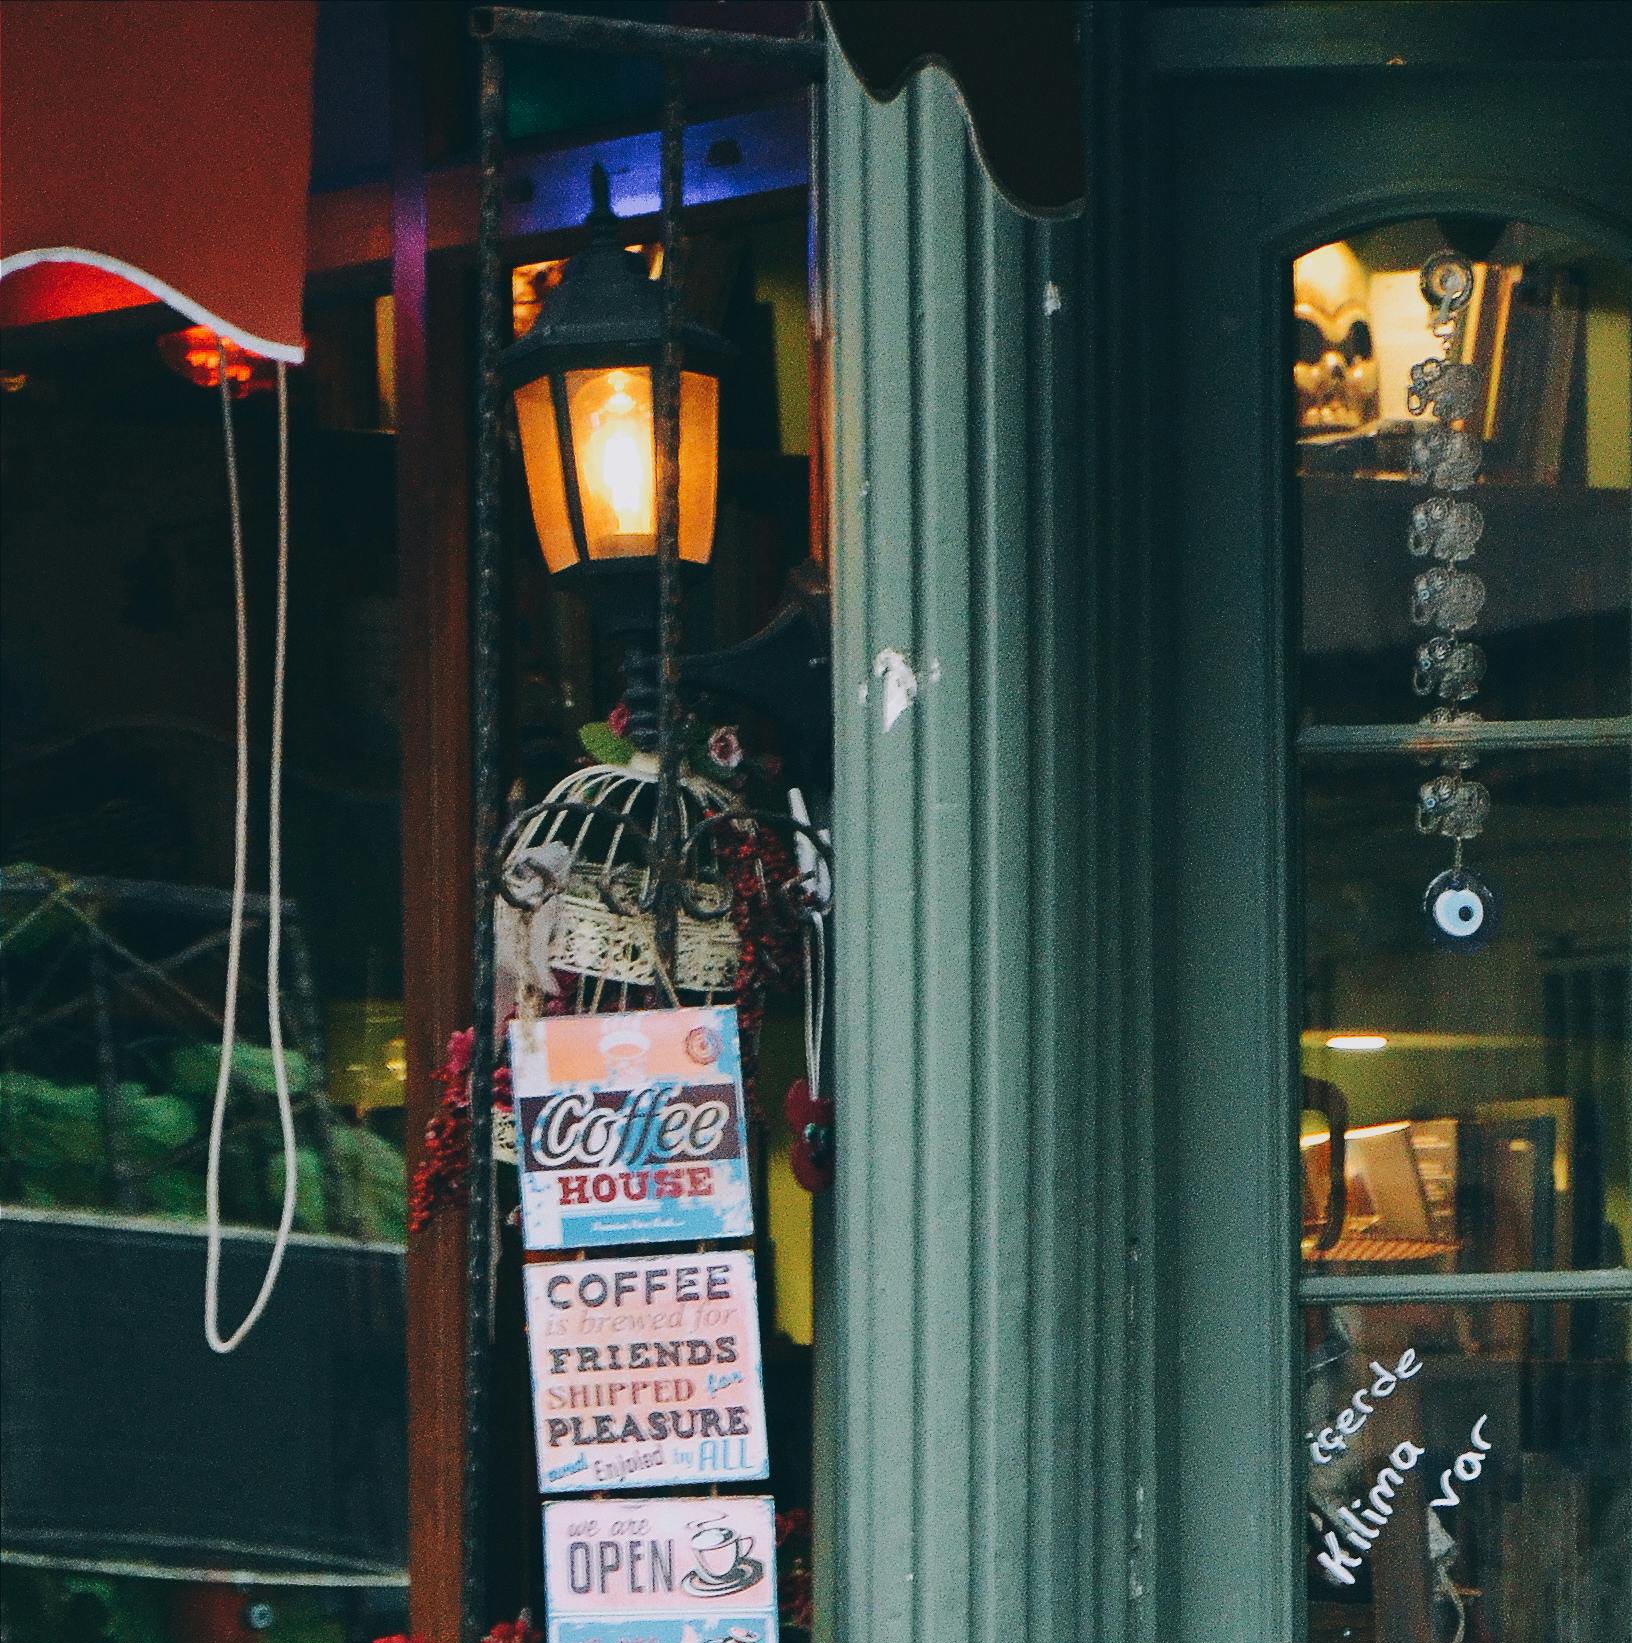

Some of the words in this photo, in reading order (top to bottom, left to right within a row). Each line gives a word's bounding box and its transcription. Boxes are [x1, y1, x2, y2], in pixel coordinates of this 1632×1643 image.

[531, 1086, 730, 1168] Coffee
[558, 1167, 712, 1206] HOUSE
[547, 1264, 731, 1310] COFFEE
[549, 1336, 737, 1375] FRIENDS
[546, 1378, 695, 1410] SHIPPED
[545, 1405, 750, 1447] PLEASURE
[699, 1437, 754, 1473] ALL
[1429, 1413, 1493, 1508] var
[569, 1540, 675, 1594] OPEN
